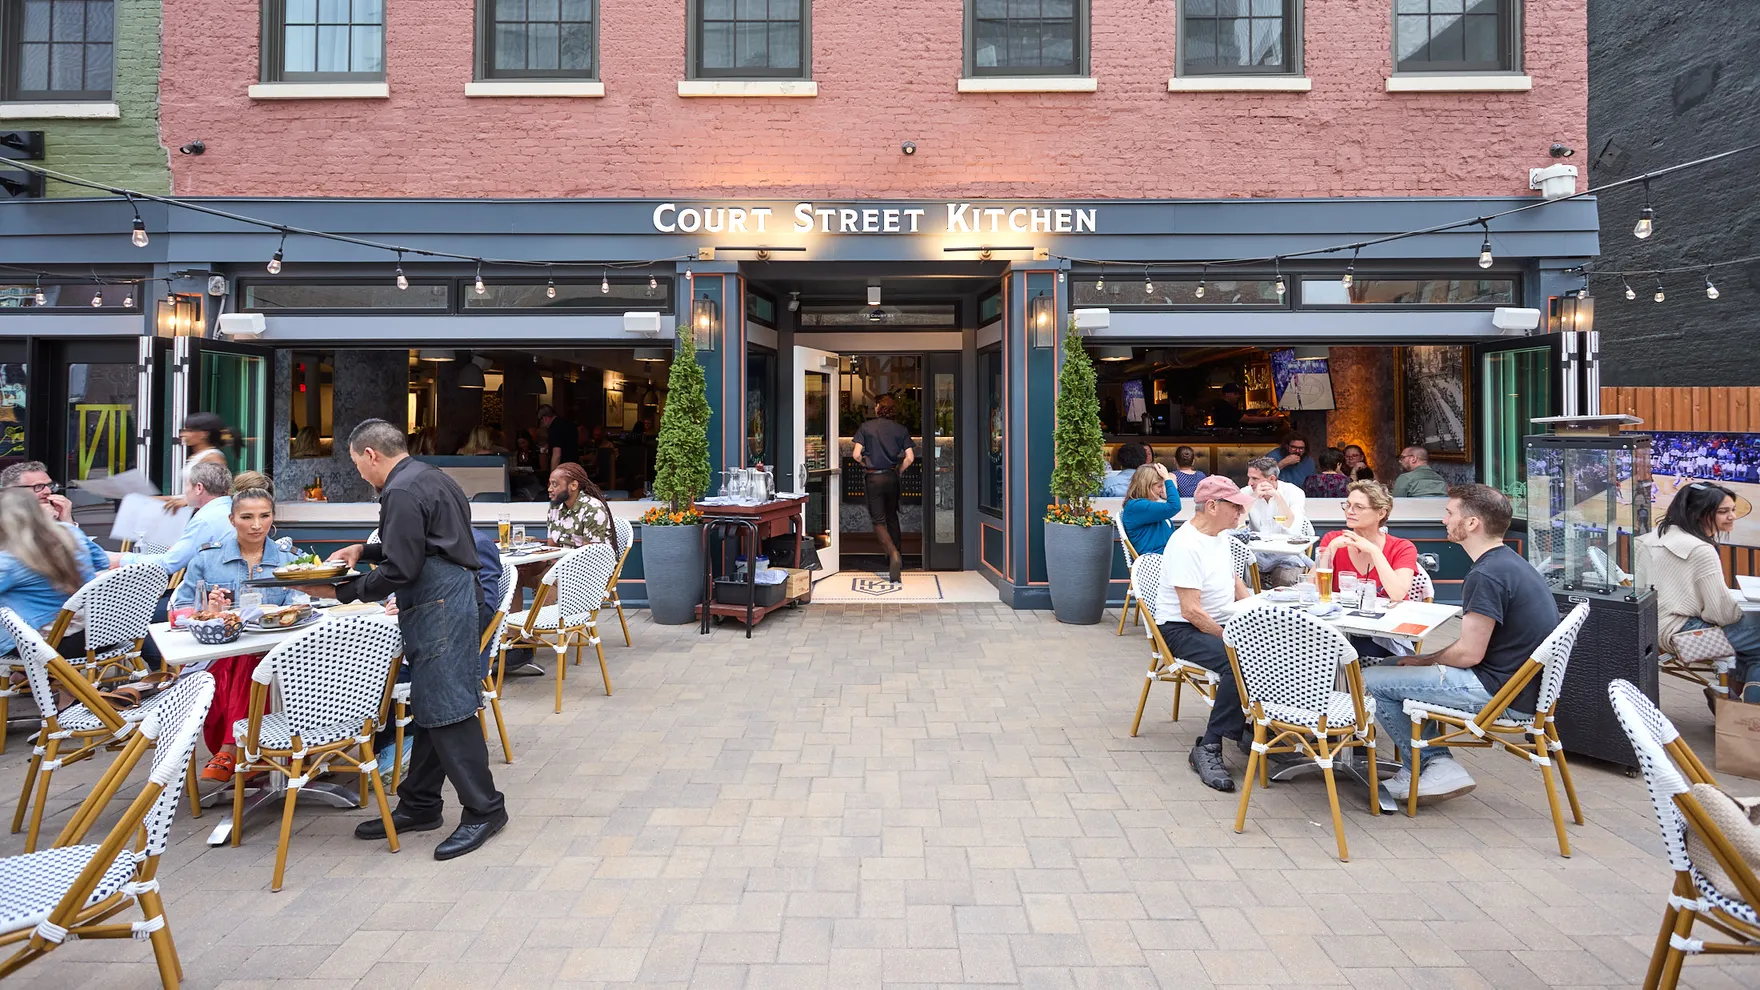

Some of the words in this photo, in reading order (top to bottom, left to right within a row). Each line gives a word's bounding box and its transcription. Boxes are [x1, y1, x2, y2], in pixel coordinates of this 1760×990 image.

[653, 203, 772, 232] COURT
[793, 203, 924, 232] STREET
[946, 203, 1097, 232] KITCHEN
